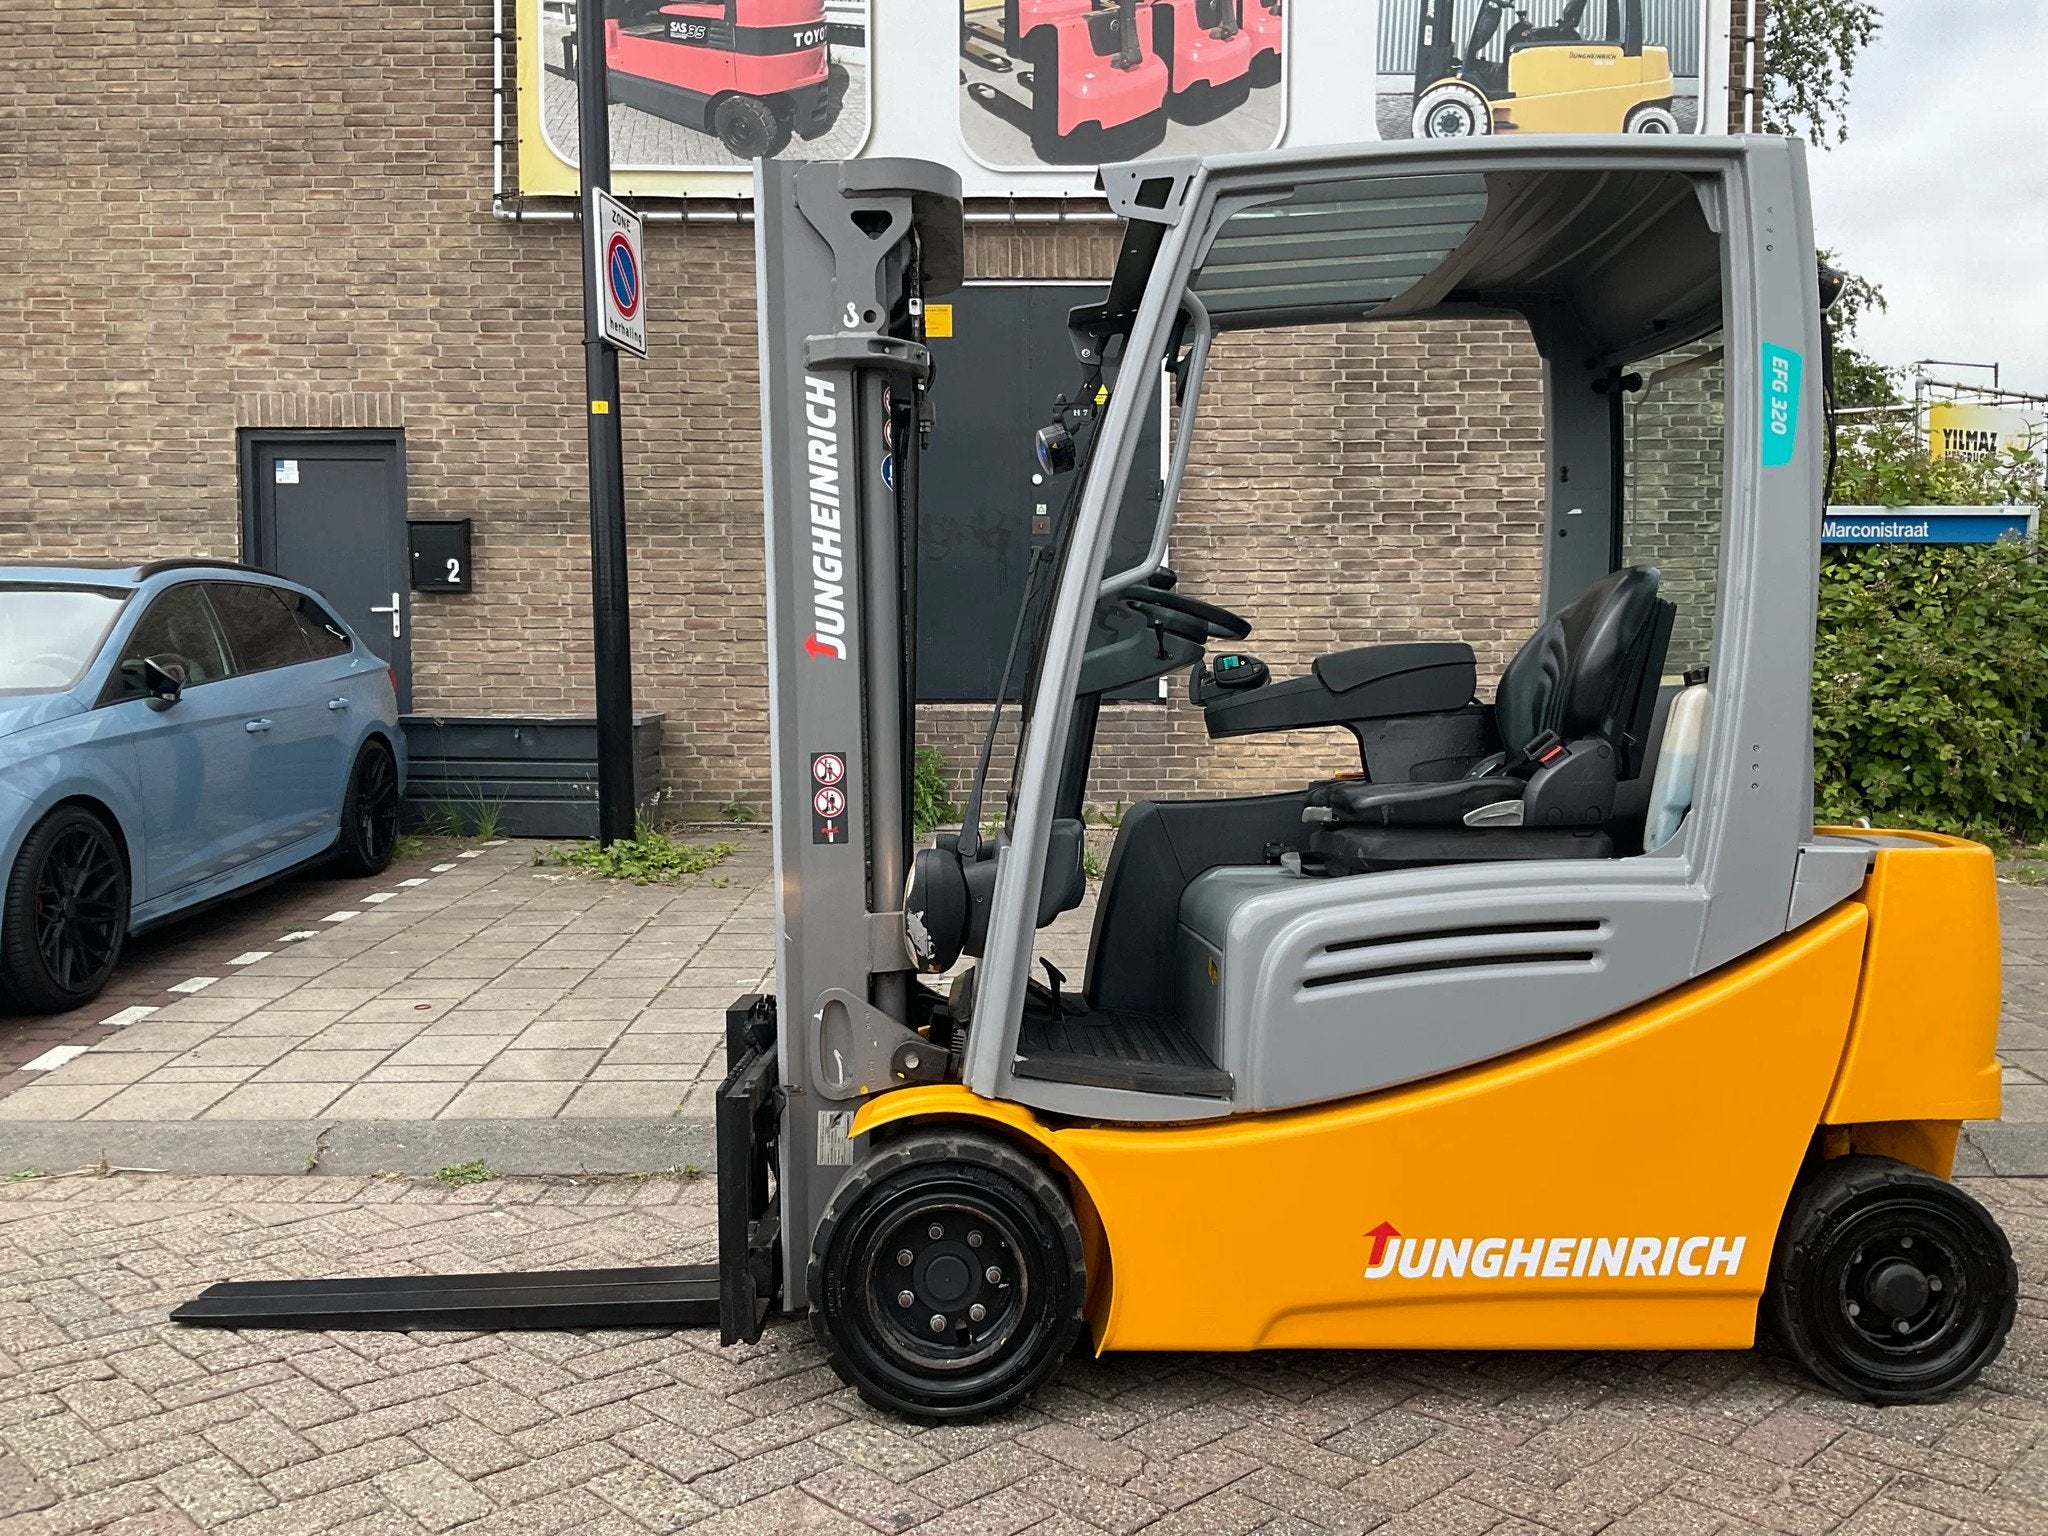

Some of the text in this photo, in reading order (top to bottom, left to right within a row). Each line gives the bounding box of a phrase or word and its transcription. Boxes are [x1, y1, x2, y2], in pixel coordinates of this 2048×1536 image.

[670, 22, 687, 33] SAS
[611, 209, 631, 233] ZONE
[610, 317, 642, 347] herhaling
[1771, 355, 1788, 435] EFG 320
[1943, 428, 1998, 452] YILMAZ
[804, 375, 847, 661] JUNGHEINRICH
[1821, 521, 1929, 538] Marconistraat
[446, 559, 461, 582] 2
[1364, 1234, 1747, 1279] JUNGHEINRICH
